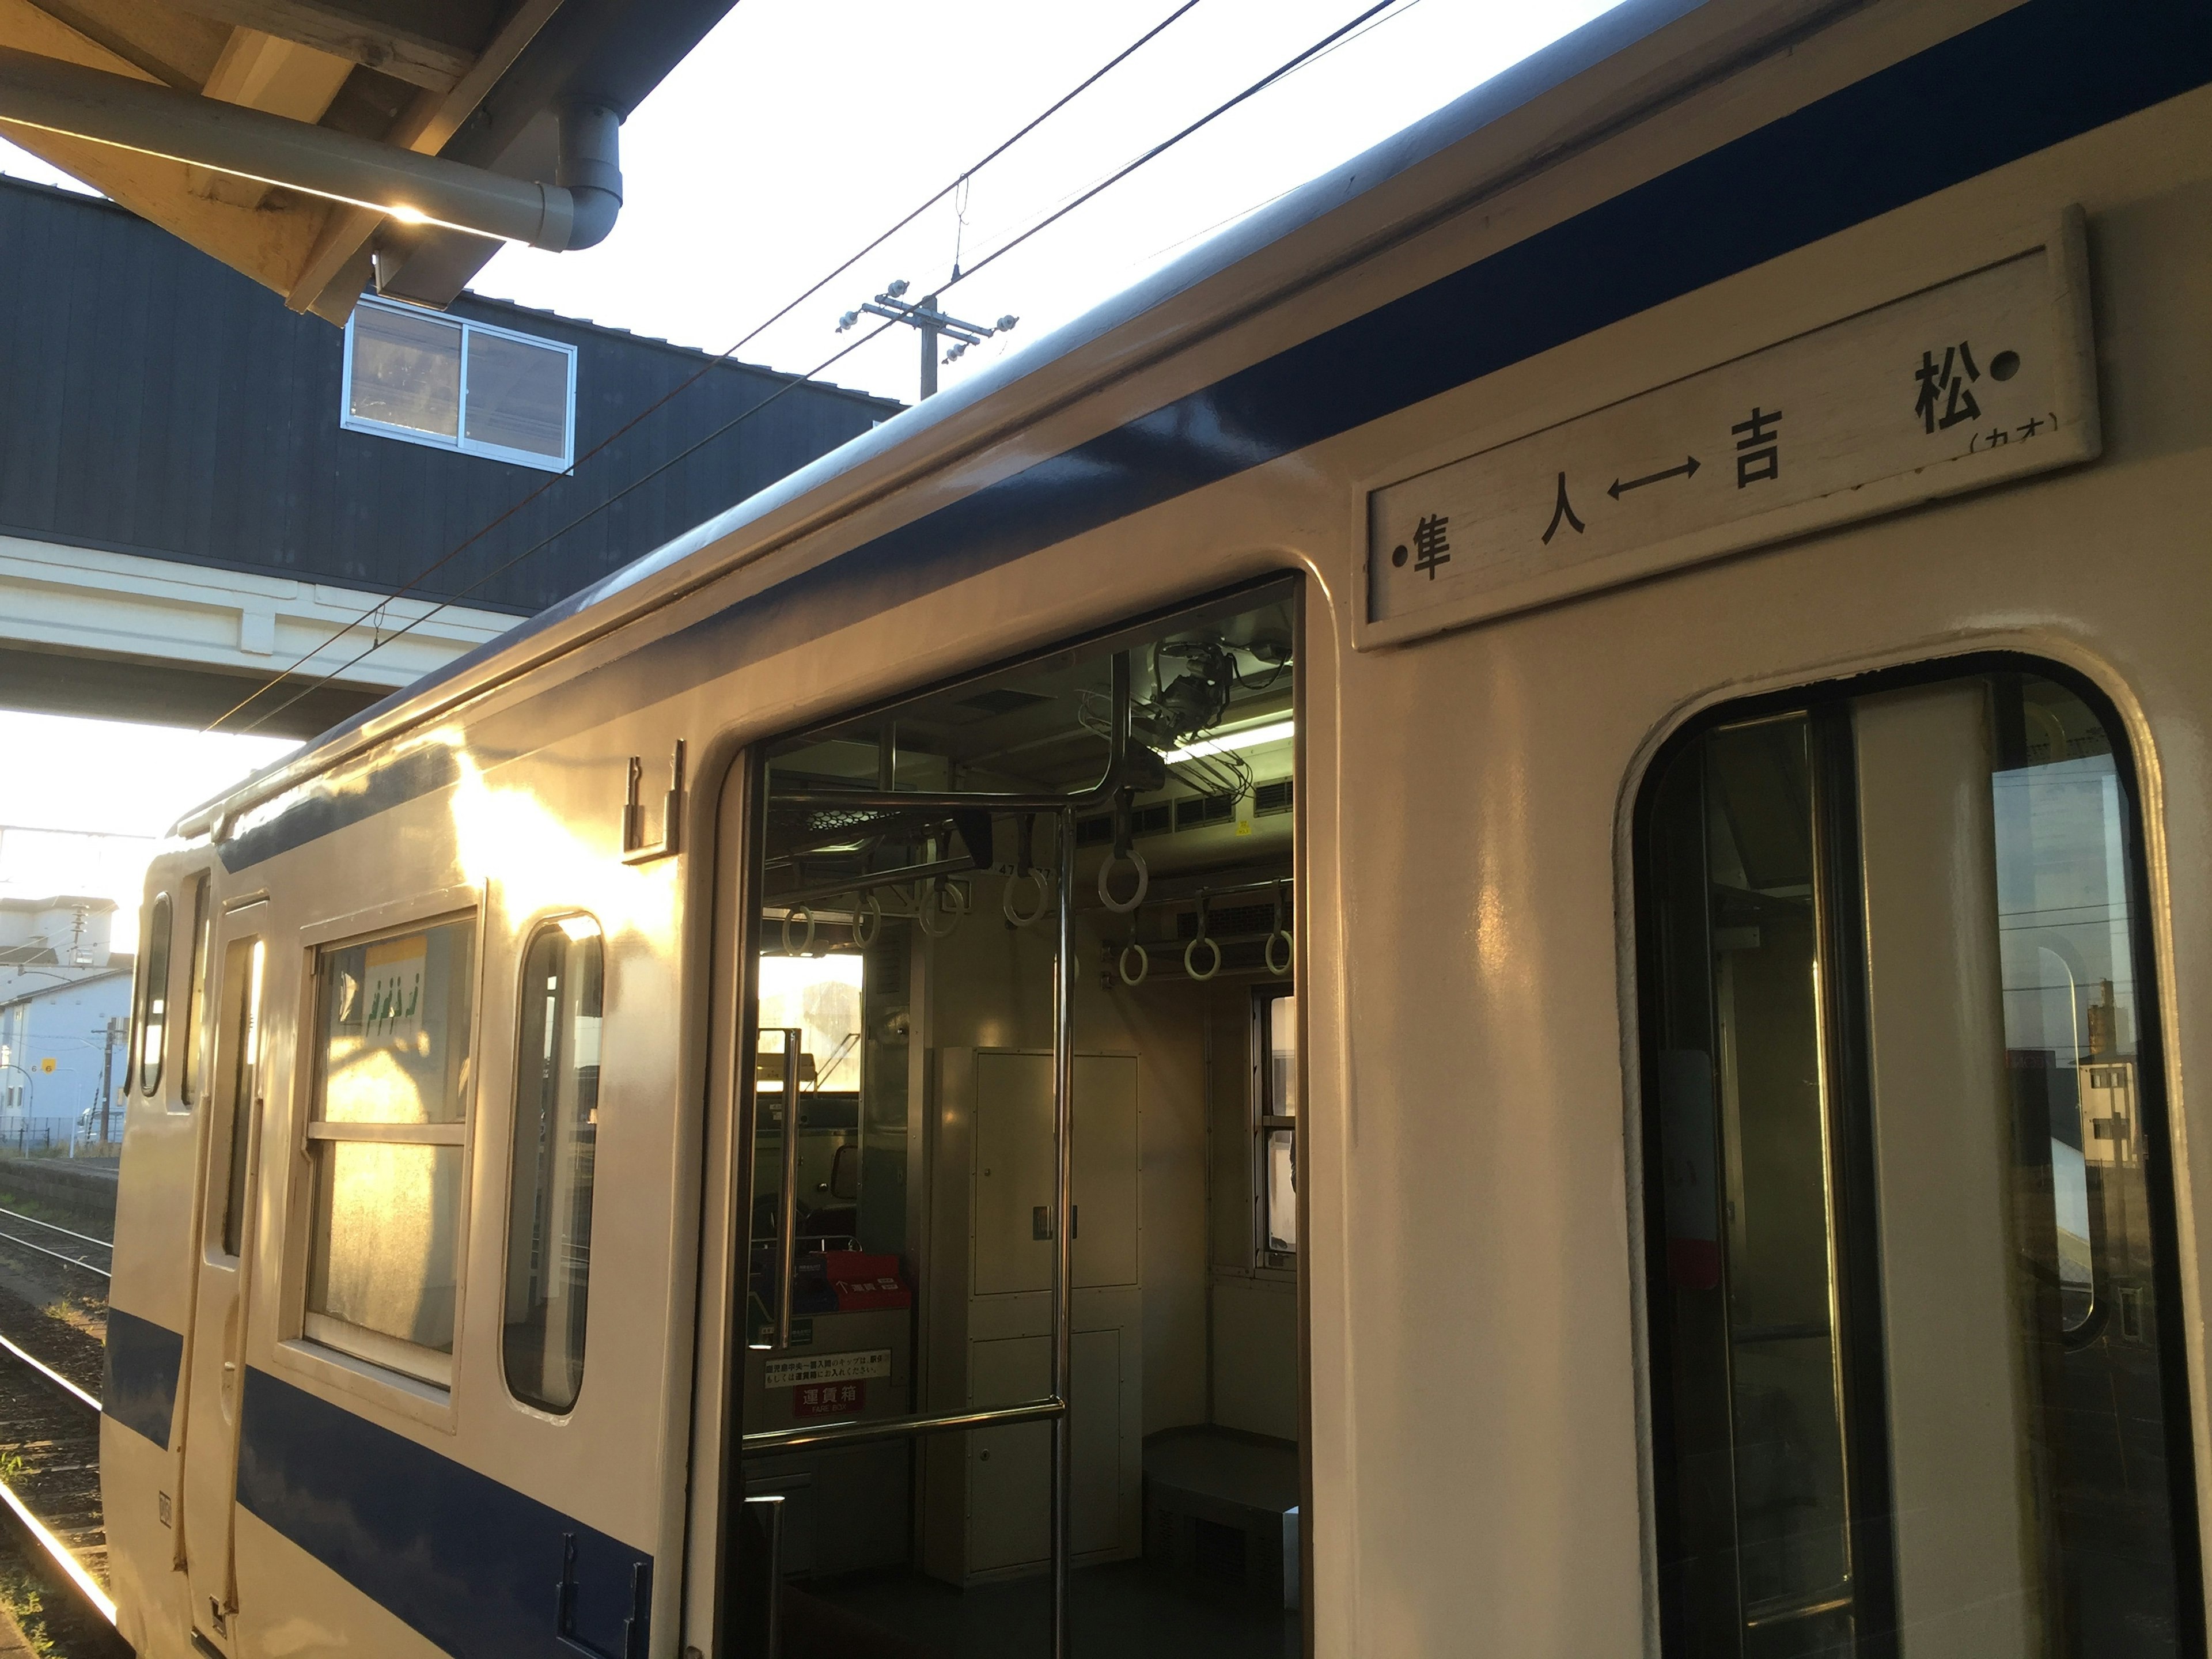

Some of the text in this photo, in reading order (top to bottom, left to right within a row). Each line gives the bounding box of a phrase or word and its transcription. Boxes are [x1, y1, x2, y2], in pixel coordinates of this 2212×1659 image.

[999, 864, 1014, 875] 47
[803, 1385, 857, 1405] 運賃箱
[812, 1403, 847, 1413] FARE BOX
